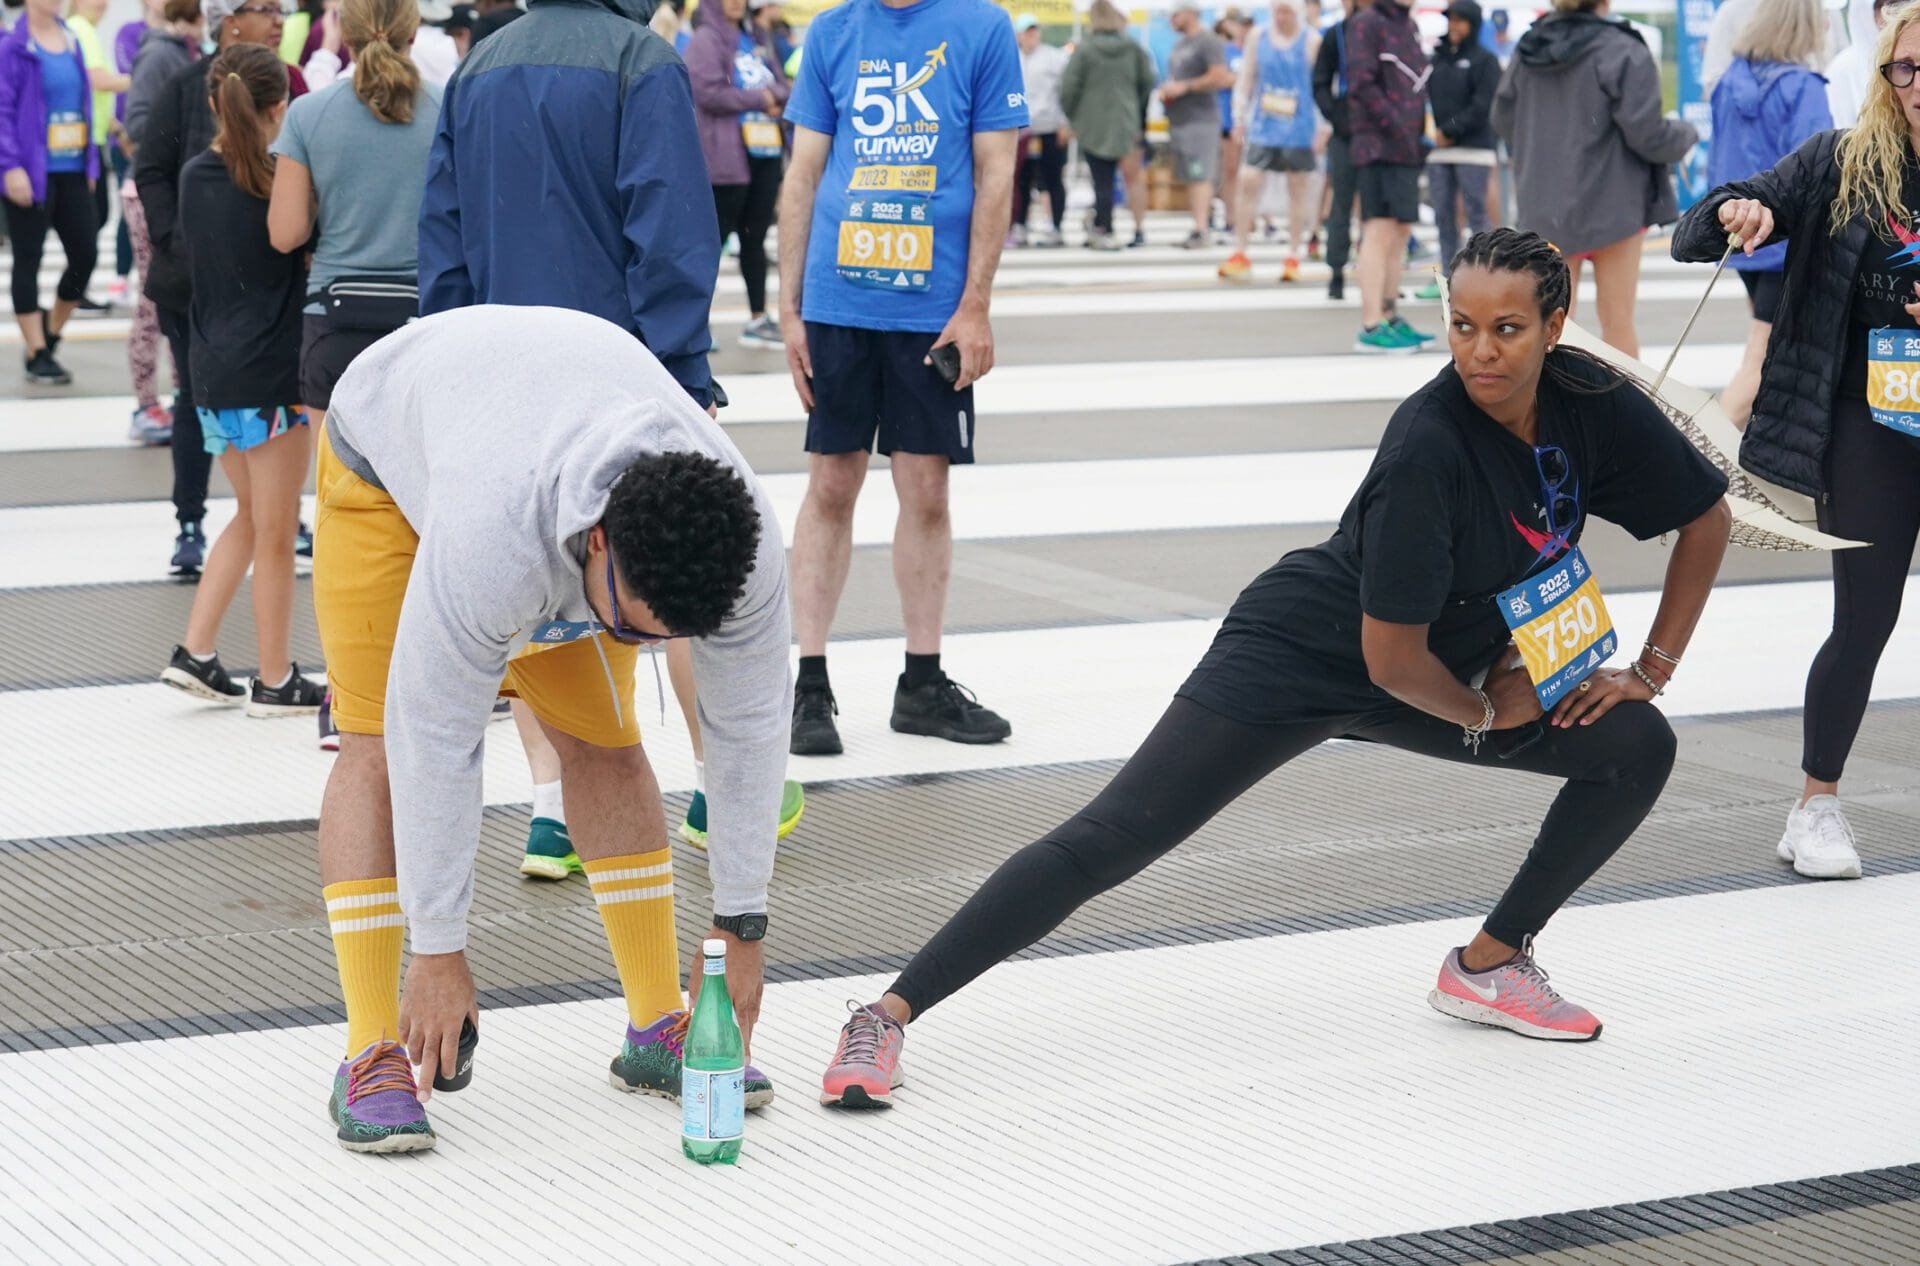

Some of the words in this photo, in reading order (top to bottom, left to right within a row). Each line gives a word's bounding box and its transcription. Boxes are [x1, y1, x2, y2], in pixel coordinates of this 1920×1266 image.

[859, 59, 892, 73] BNA
[852, 62, 940, 136] 5K
[895, 124, 911, 134] on
[914, 120, 939, 133] the
[854, 135, 939, 159] runway
[858, 169, 888, 187] 2023
[900, 169, 931, 178] NASH
[872, 202, 903, 214] 2023
[853, 229, 918, 262] 910
[1538, 569, 1569, 598] 2023
[1510, 596, 1531, 614] 5K
[1534, 595, 1597, 663] 750
[1542, 679, 1561, 697] FINN
